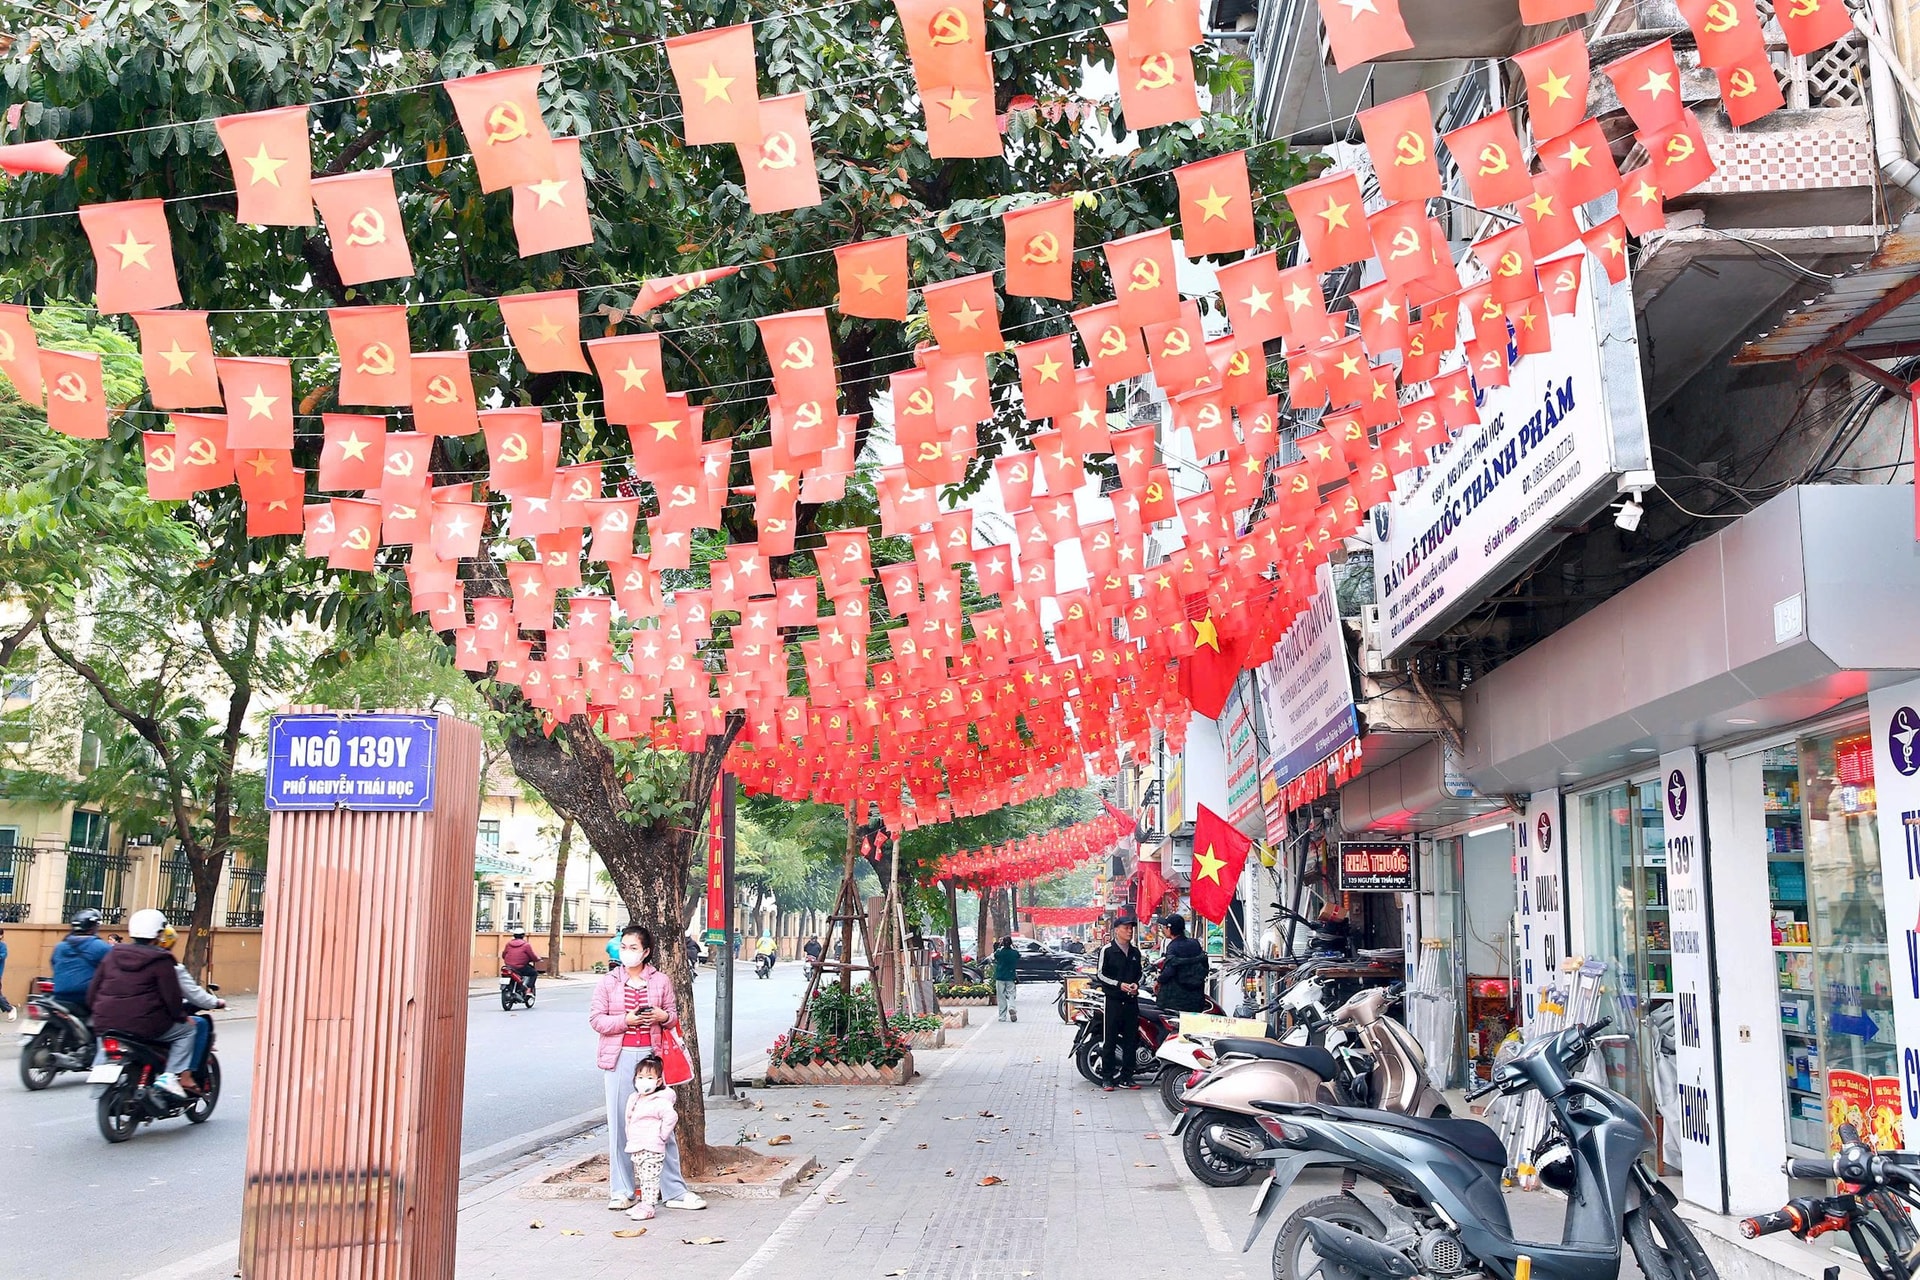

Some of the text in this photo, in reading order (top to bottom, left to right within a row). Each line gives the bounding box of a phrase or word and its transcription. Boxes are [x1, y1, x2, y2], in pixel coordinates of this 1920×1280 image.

[1472, 428, 1488, 457] THÁI
[1489, 411, 1504, 442] HỌC
[1384, 376, 1576, 598] BÁN LẺ THUỐC THÀNH PHẨM
[290, 729, 412, 768] NGÕ 139Y
[282, 774, 413, 799] PHỐ NGUYỄN THÁI HỌC
[1345, 848, 1408, 873] NHÀ THUỐC
[1358, 874, 1380, 884] NGUYỄN
[1381, 874, 1393, 884] THÁI
[1394, 877, 1406, 885] HỌC
[1536, 874, 1559, 921] DỤNG
[197, 927, 208, 937] 20
[1544, 934, 1556, 981] CỤ
[1679, 981, 1701, 1048] NHÀ
[1679, 1067, 1709, 1146] THUỐC
